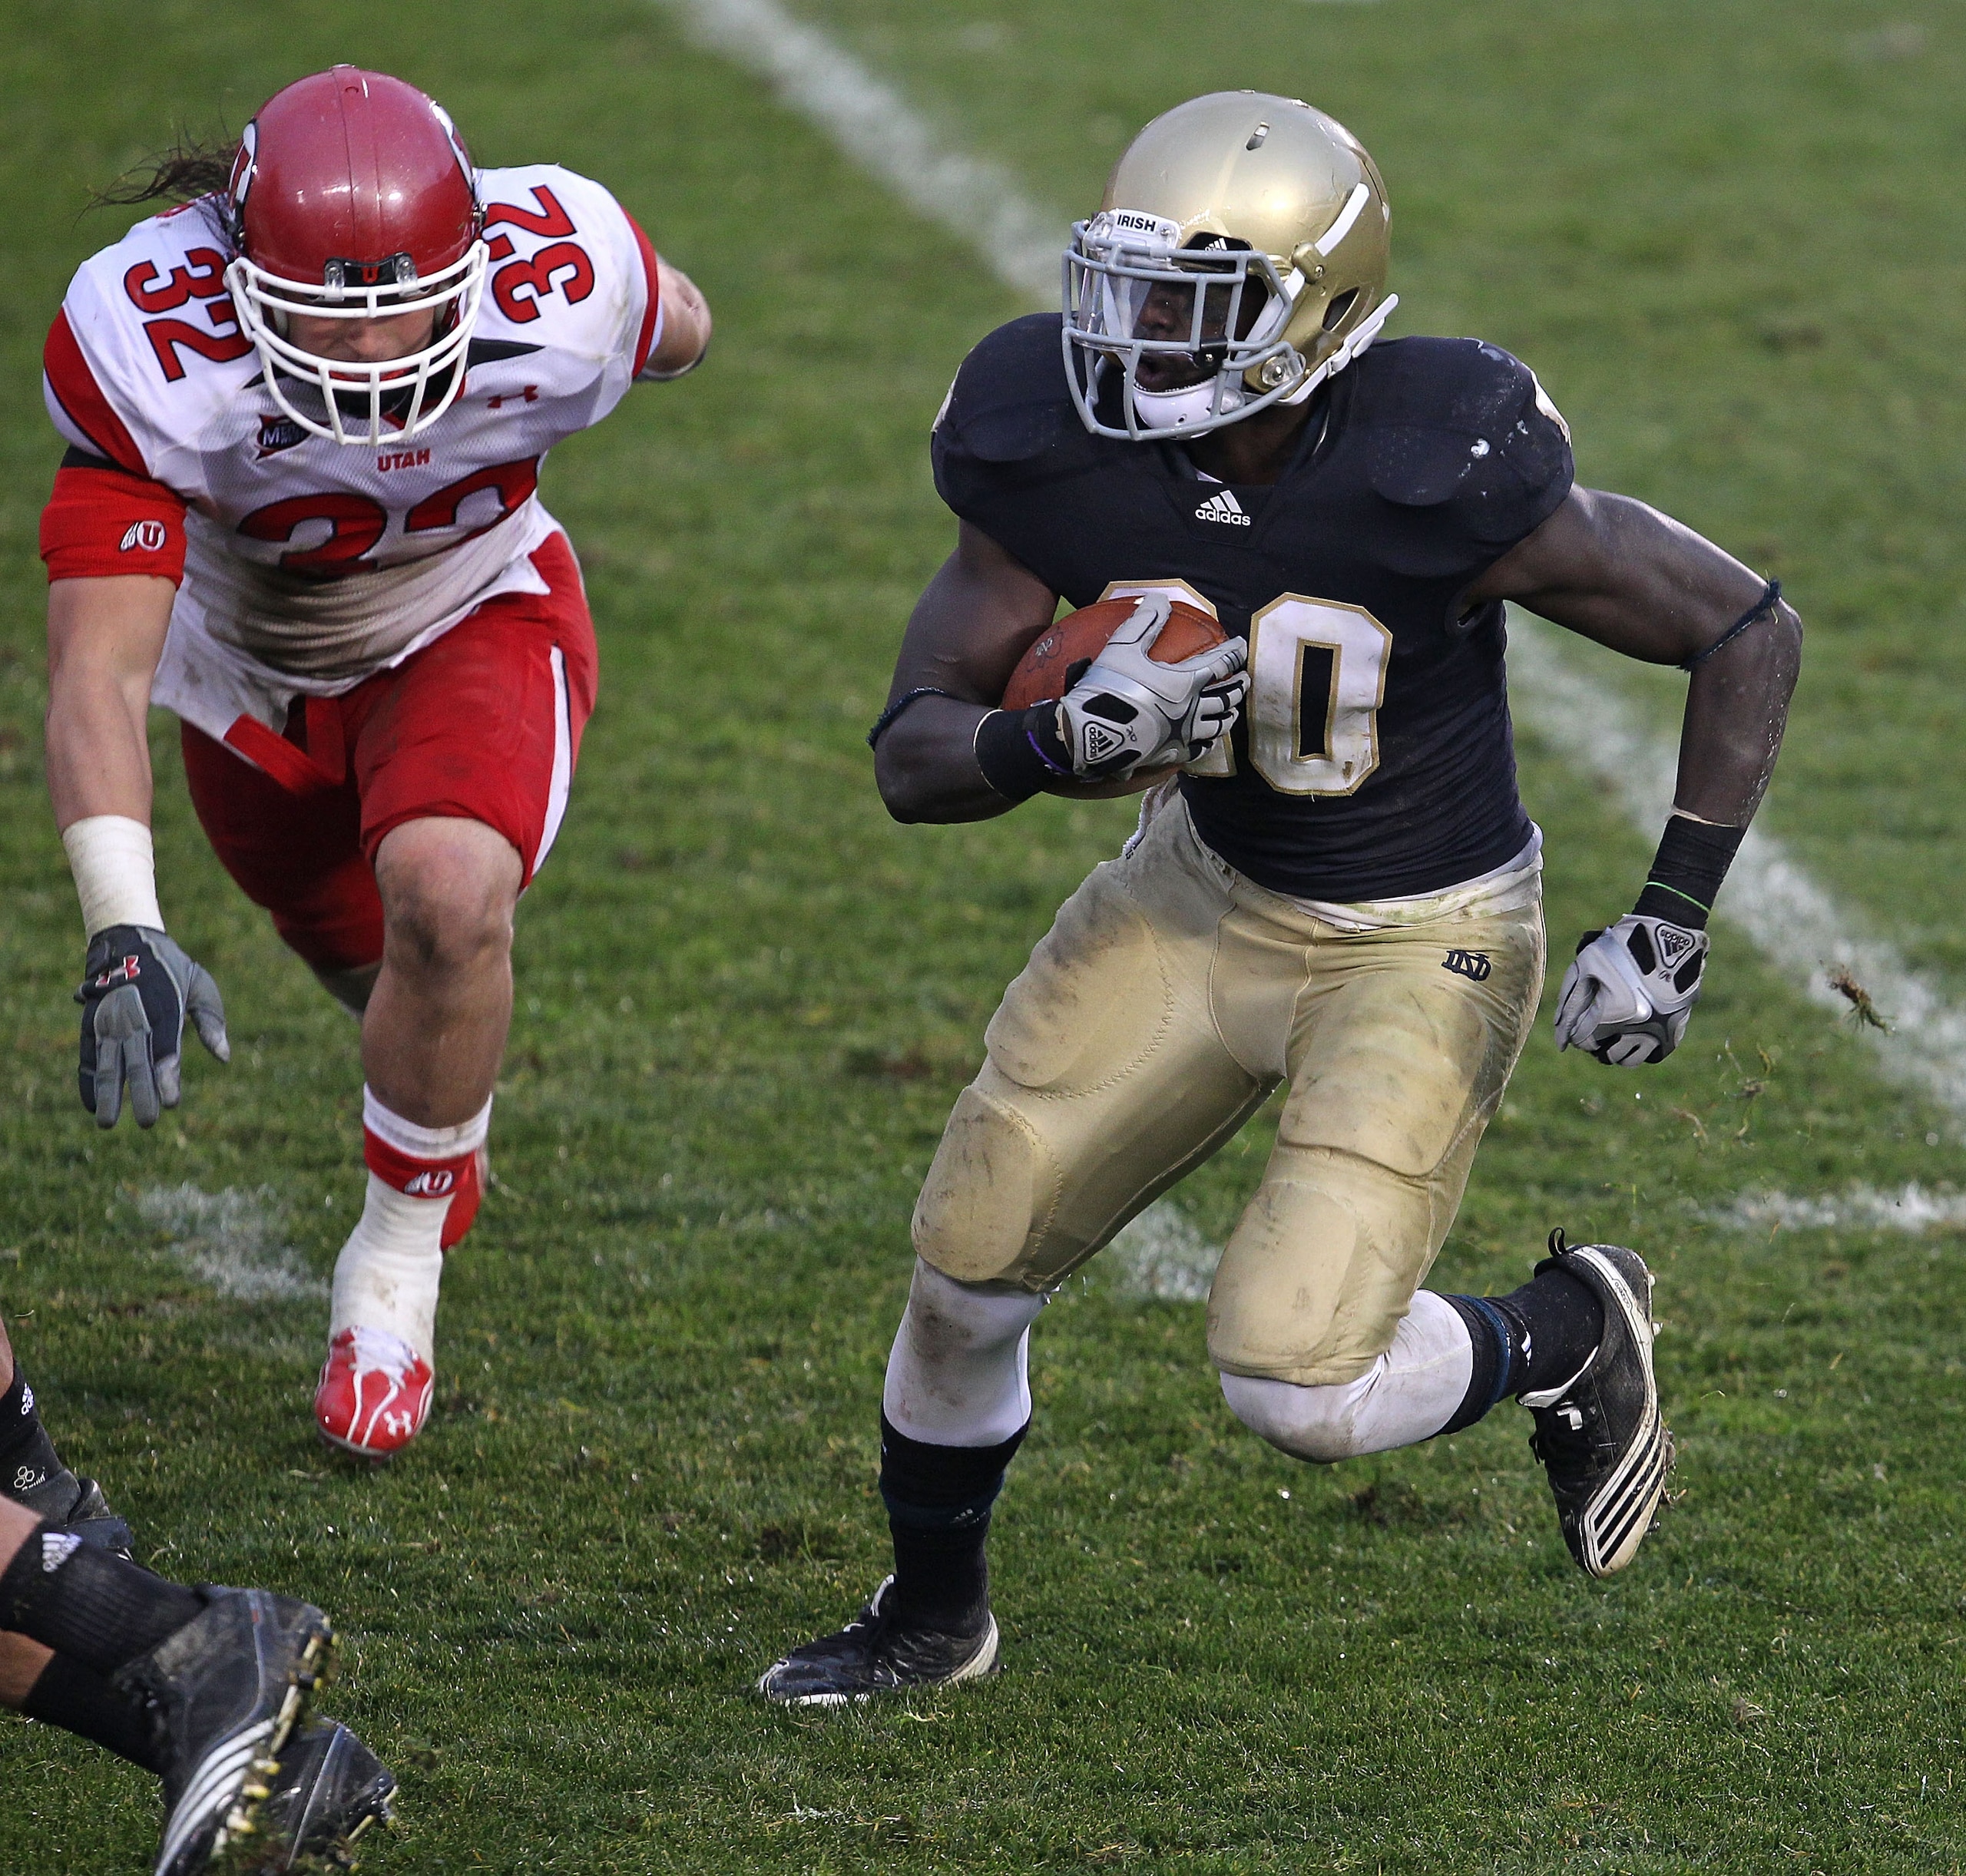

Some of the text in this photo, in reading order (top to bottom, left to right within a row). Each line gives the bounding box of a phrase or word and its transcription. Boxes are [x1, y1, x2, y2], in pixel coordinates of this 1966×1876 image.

[1117, 213, 1157, 232] IRISH
[475, 184, 595, 324] 32
[361, 266, 380, 283] U
[124, 246, 256, 383] 32
[377, 448, 431, 472] UTAH
[1195, 508, 1252, 526] adidas
[1089, 726, 1098, 759] adidas
